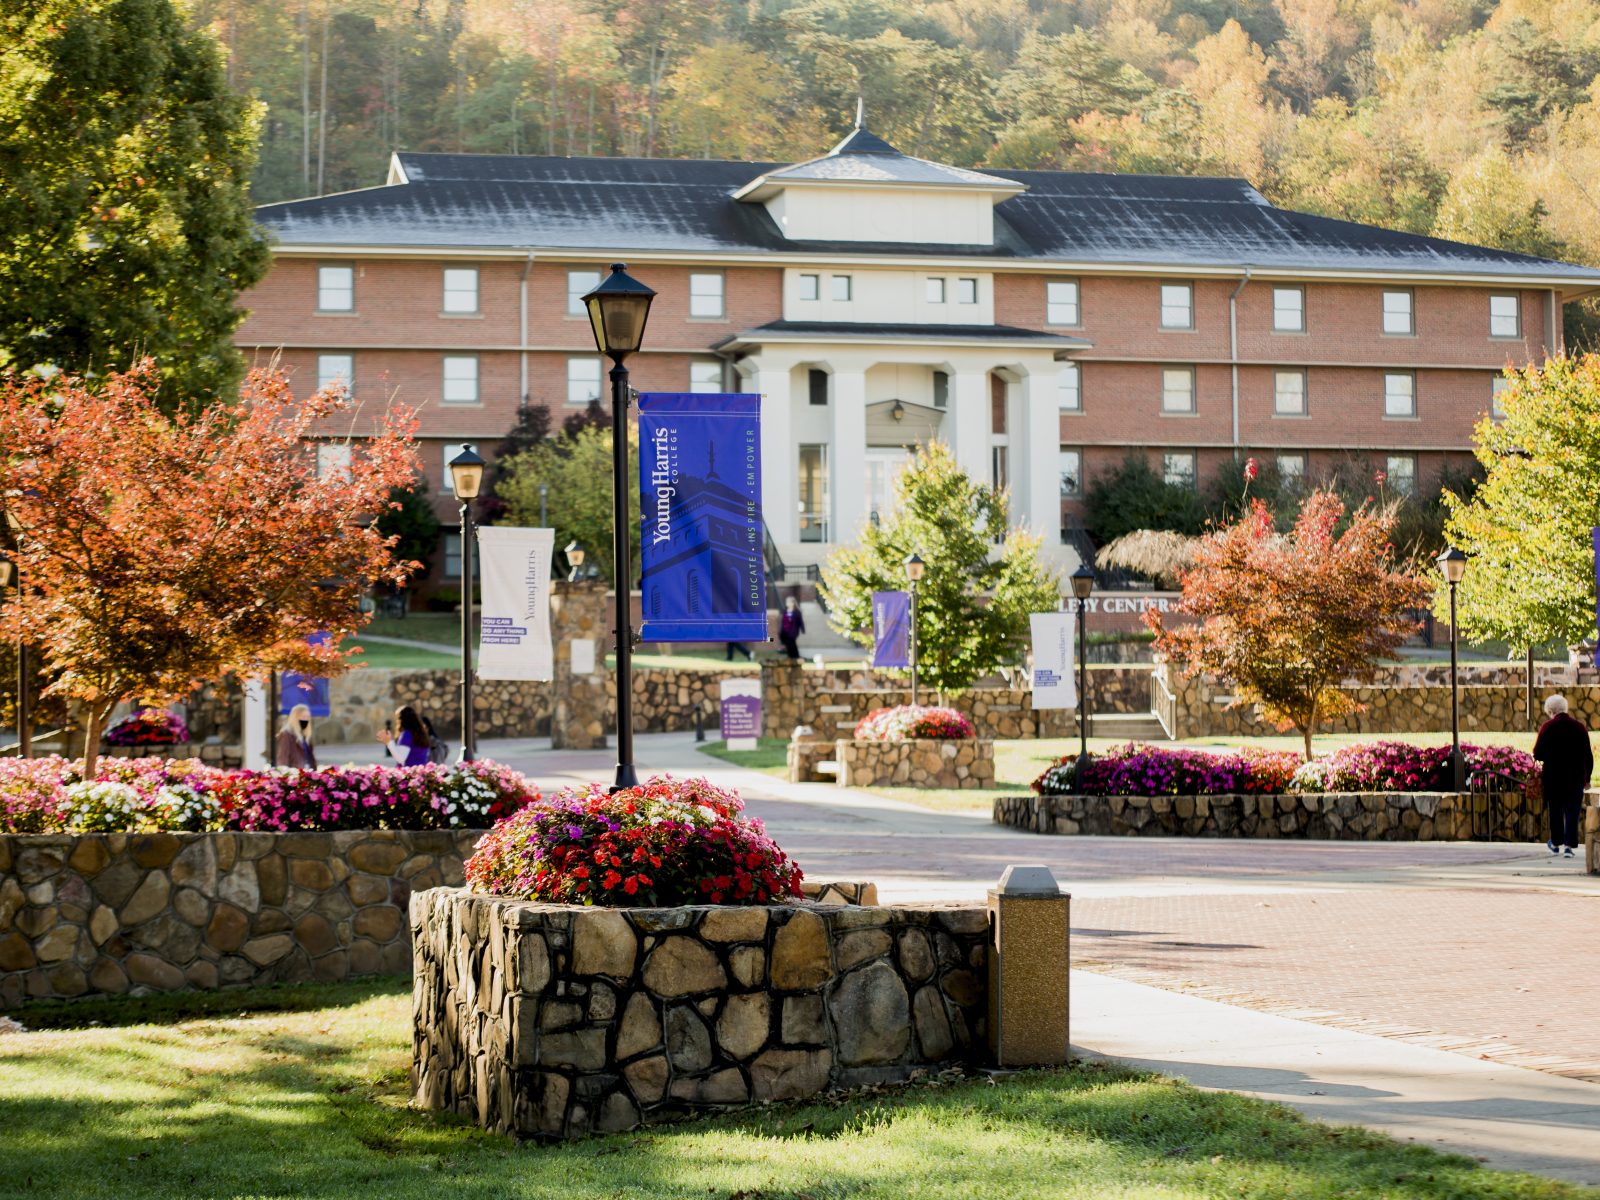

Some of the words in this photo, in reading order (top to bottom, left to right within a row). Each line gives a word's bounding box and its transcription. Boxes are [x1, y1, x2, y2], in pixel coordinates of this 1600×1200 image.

[670, 428, 679, 485] COLLEGE
[746, 429, 755, 487] EMPOWER
[747, 500, 756, 544] INSPIRE
[748, 555, 760, 607] EDUCATE
[1102, 597, 1169, 613] CENTER
